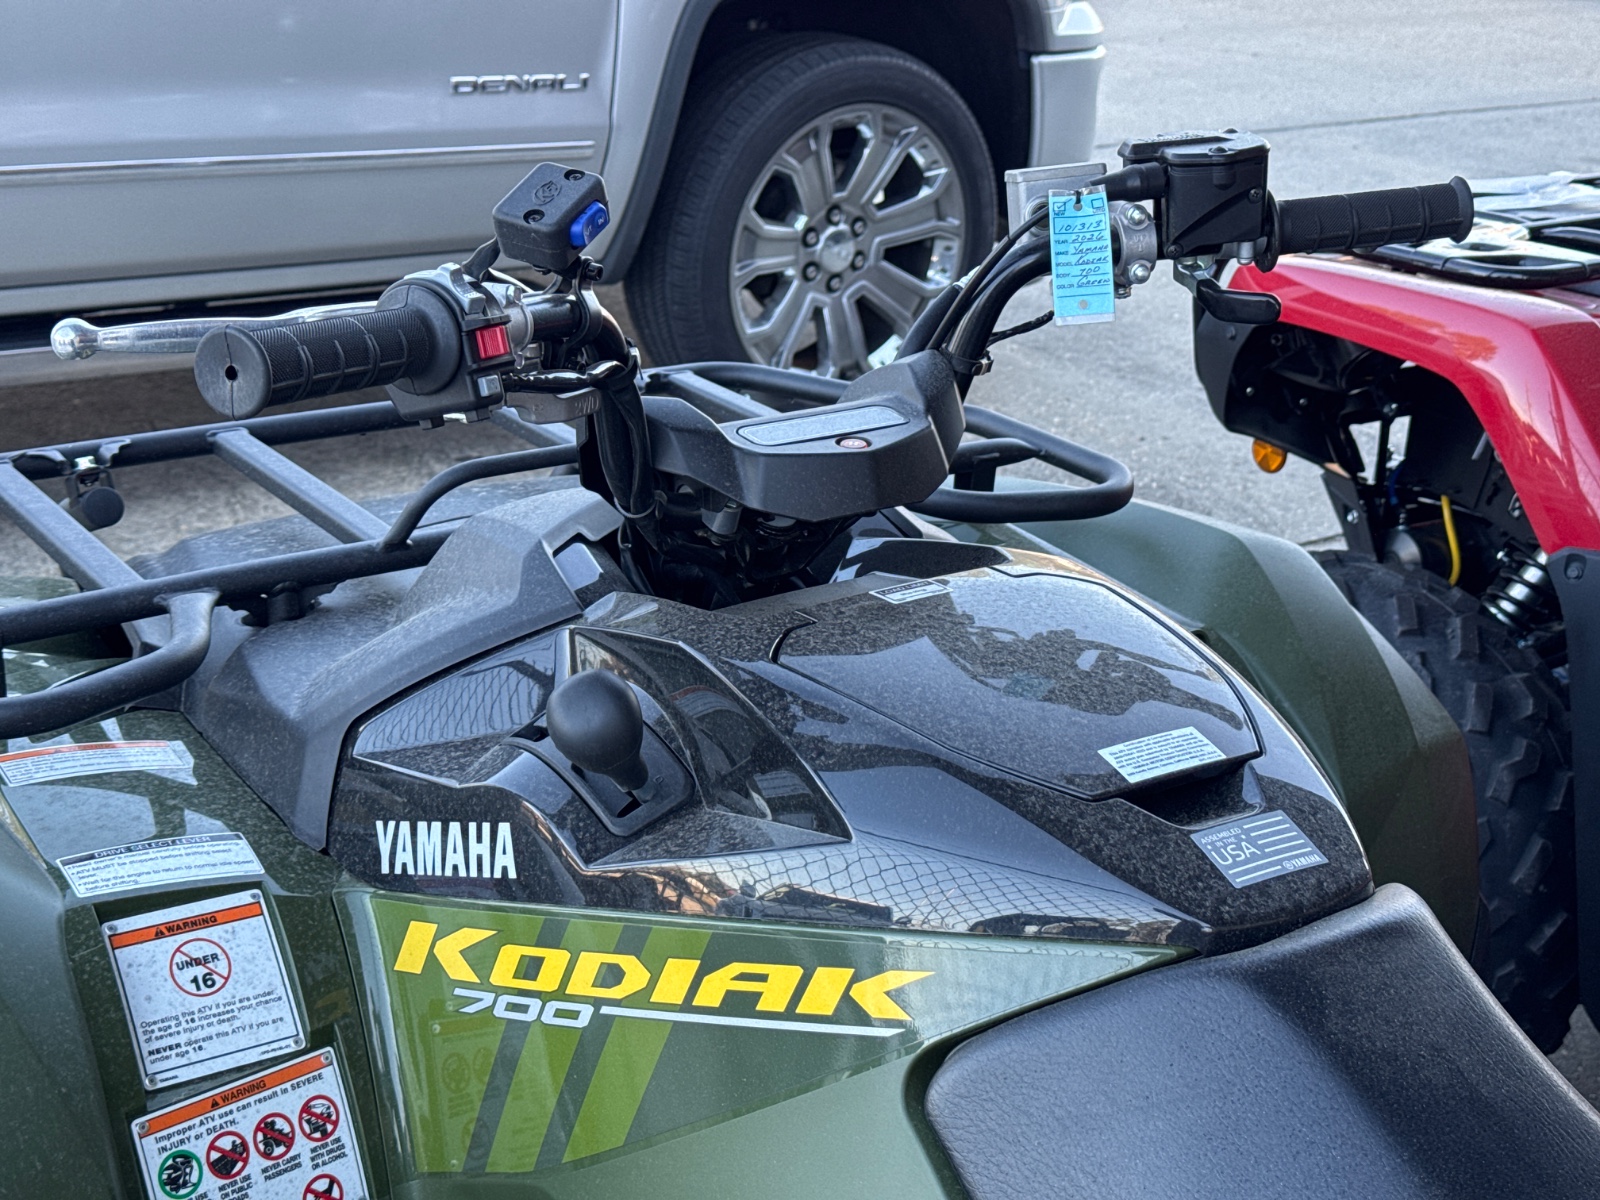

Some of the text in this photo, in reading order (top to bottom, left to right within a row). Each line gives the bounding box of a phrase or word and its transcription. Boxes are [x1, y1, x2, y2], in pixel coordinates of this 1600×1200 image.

[450, 72, 590, 94] DENALI
[1058, 220, 1102, 232] 101313
[1072, 232, 1105, 244] 2026
[1080, 266, 1101, 276] 700
[575, 396, 599, 416] 2WD
[1201, 827, 1242, 844] ASSEMBLED
[1224, 837, 1237, 846] THE
[94, 836, 211, 858] DRIVE SELECT LEVER
[376, 820, 517, 879] YAMAHA
[1211, 841, 1261, 865] USA
[92, 863, 115, 872] MUST
[129, 856, 158, 864] stopped
[1291, 854, 1322, 868] YAMAHA
[126, 870, 152, 878] engine
[86, 883, 110, 891] before
[165, 915, 218, 934] WARNING
[176, 952, 220, 971] UNDER
[393, 920, 936, 1020] KODIAK
[190, 972, 216, 992] 16
[140, 1014, 180, 1028] Operating
[181, 1010, 196, 1018] this
[197, 1004, 213, 1014] ATV
[222, 1000, 236, 1009] you
[252, 990, 274, 1000] under
[142, 1028, 156, 1036] the
[158, 1024, 172, 1032] age
[184, 1017, 196, 1026] 16
[197, 1007, 236, 1022] increases
[236, 1003, 254, 1014] your
[255, 996, 282, 1008] chance
[452, 988, 594, 1028] 700
[144, 1036, 152, 1044] of
[154, 1030, 182, 1041] severe
[182, 1023, 205, 1034] injury
[216, 1014, 240, 1025] death.
[148, 1042, 182, 1056] NEVER
[184, 1034, 214, 1048] operate
[214, 1030, 230, 1039] this
[231, 1024, 246, 1035] ATV
[256, 1020, 270, 1030] you
[271, 1016, 284, 1024] are
[149, 1044, 206, 1064] under age 16.
[220, 1079, 267, 1104] WARNING
[154, 1072, 324, 1144] Improper ATV use can result in SEVERE
[158, 1118, 240, 1156] INJURY or DEATH.
[310, 1136, 342, 1154] NEVER USE
[310, 1143, 346, 1163] WITH DRUGS
[312, 1151, 348, 1170] OR ALCOHOL
[261, 1152, 302, 1175] NEVER CARRY
[264, 1160, 303, 1182] PASSENGERS
[218, 1173, 252, 1192] NEVER USE
[220, 1182, 254, 1200] ON PUBLIC
